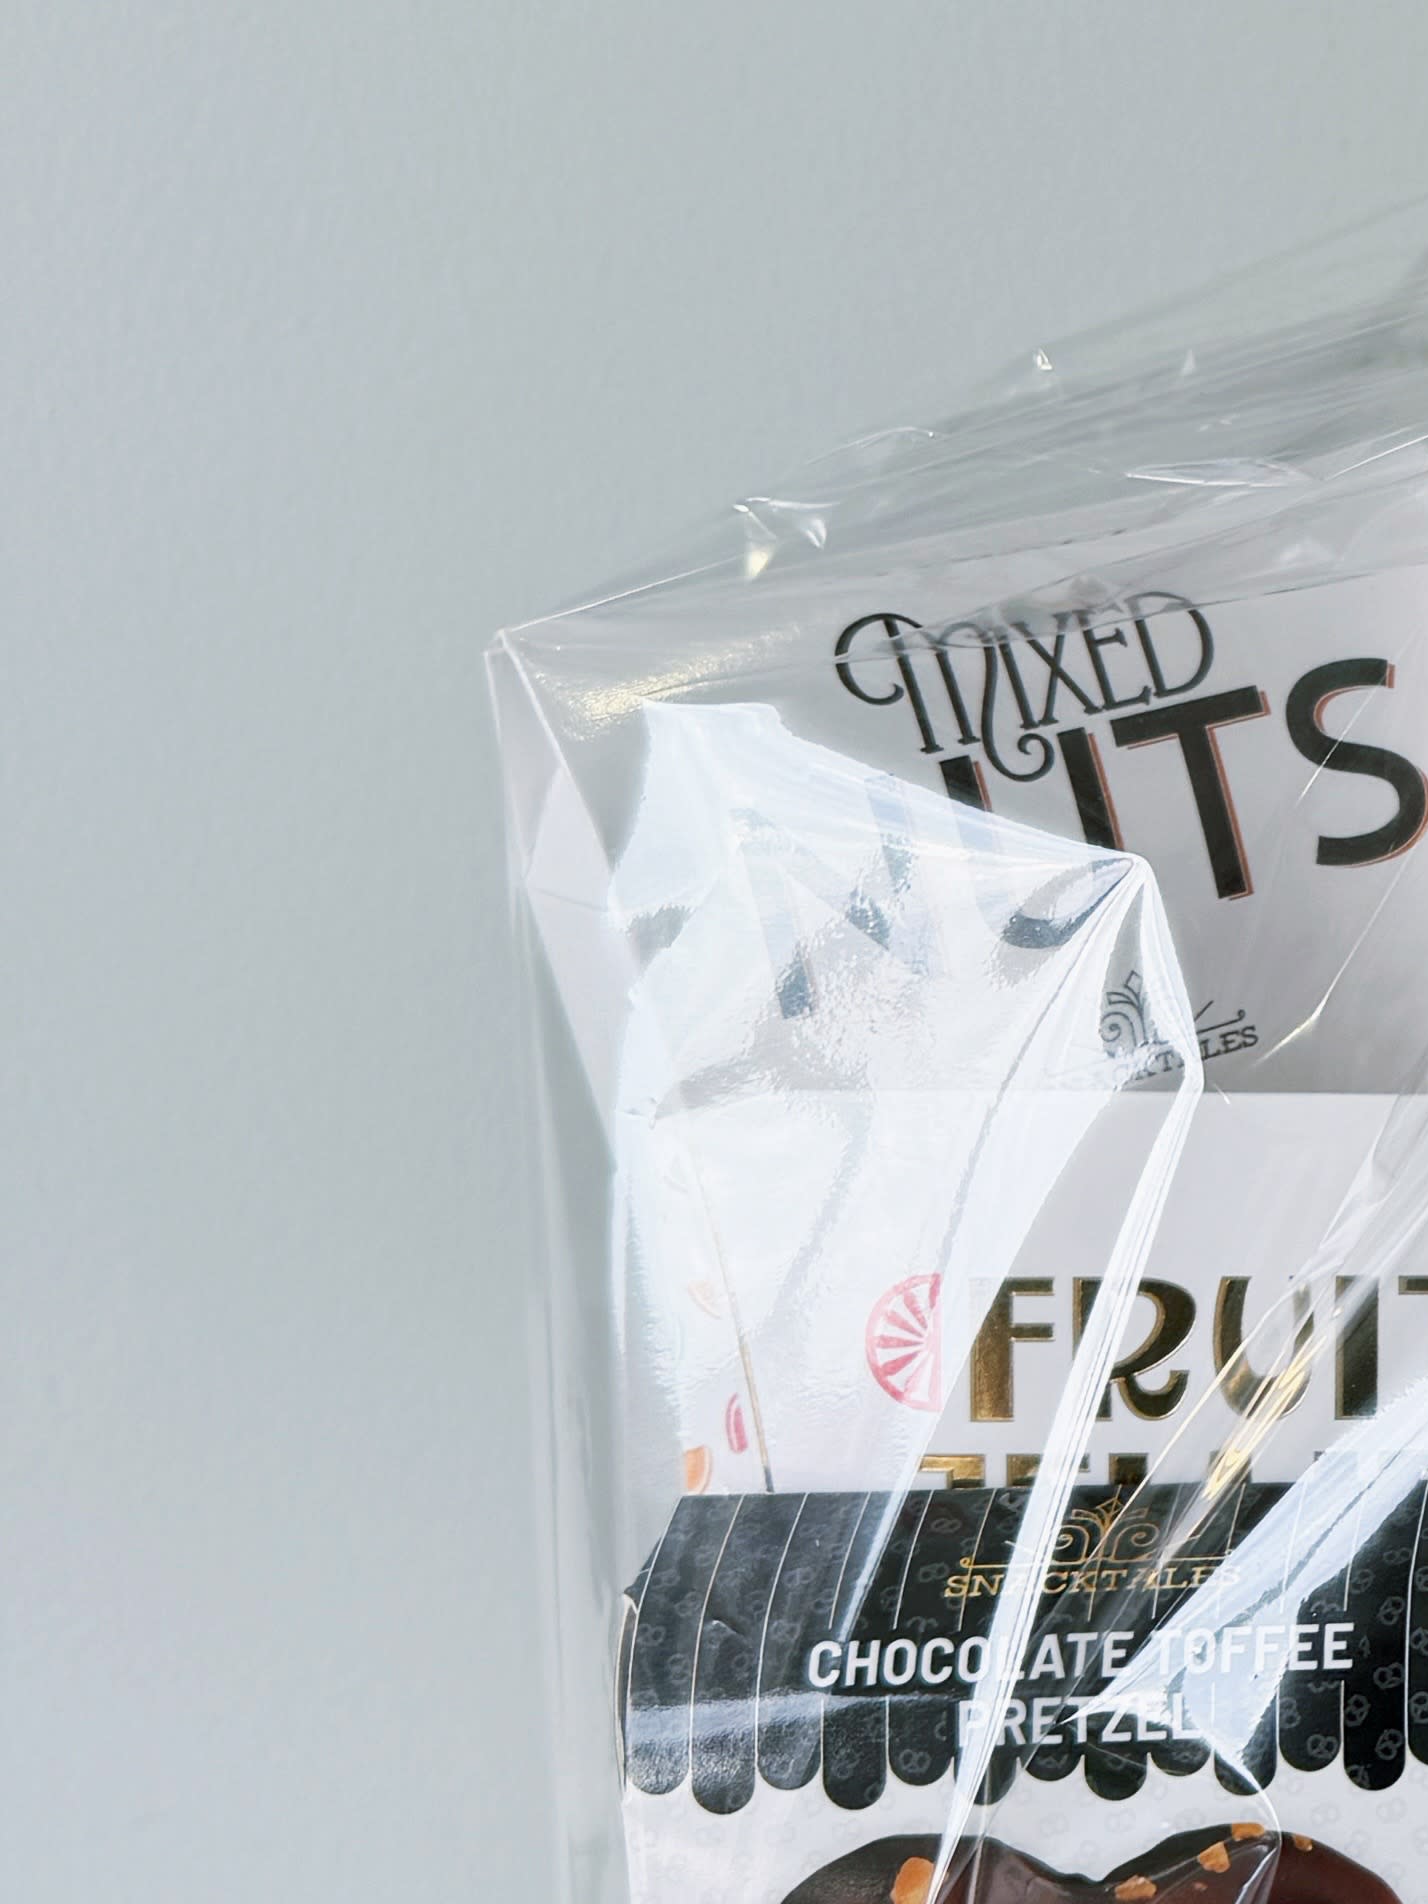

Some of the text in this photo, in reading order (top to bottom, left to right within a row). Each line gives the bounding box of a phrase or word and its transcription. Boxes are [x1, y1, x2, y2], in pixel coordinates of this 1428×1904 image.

[833, 588, 1216, 782] MIXED
[944, 1564, 1241, 1598] SNCKTALES
[809, 1622, 1355, 1688] CHOCOLATE TOFFEE
